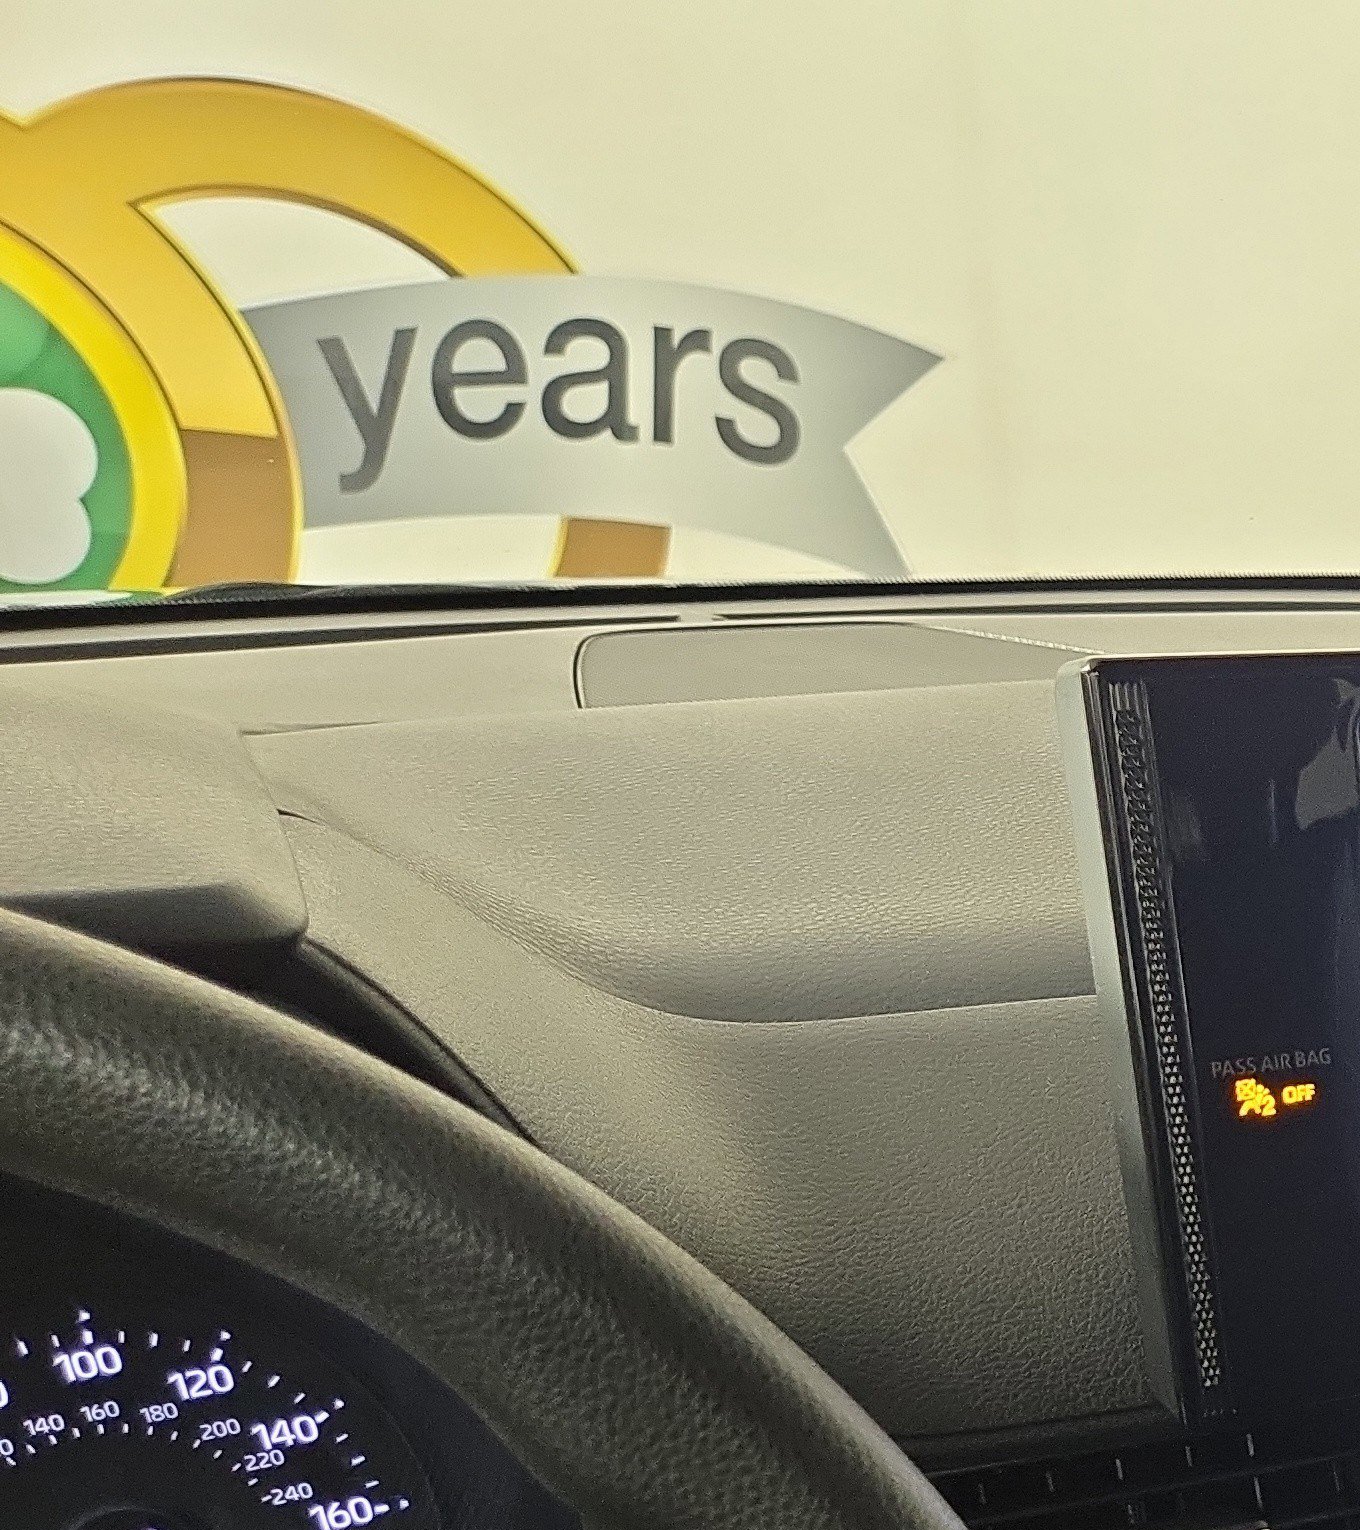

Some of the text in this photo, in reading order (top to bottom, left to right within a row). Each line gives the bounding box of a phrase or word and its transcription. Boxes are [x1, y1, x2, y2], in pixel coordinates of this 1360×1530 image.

[316, 316, 802, 495] years
[1211, 1048, 1332, 1078] PASS AIR BAG
[1282, 1084, 1316, 1104] OFF
[52, 1346, 123, 1384] 100
[167, 1363, 235, 1400] 120
[79, 1400, 120, 1422] 160
[139, 1402, 179, 1424] 180
[23, 1414, 65, 1436] 140
[200, 1418, 241, 1442] 200
[252, 1414, 319, 1451] 140
[243, 1448, 285, 1471] 220
[271, 1482, 314, 1504] 240
